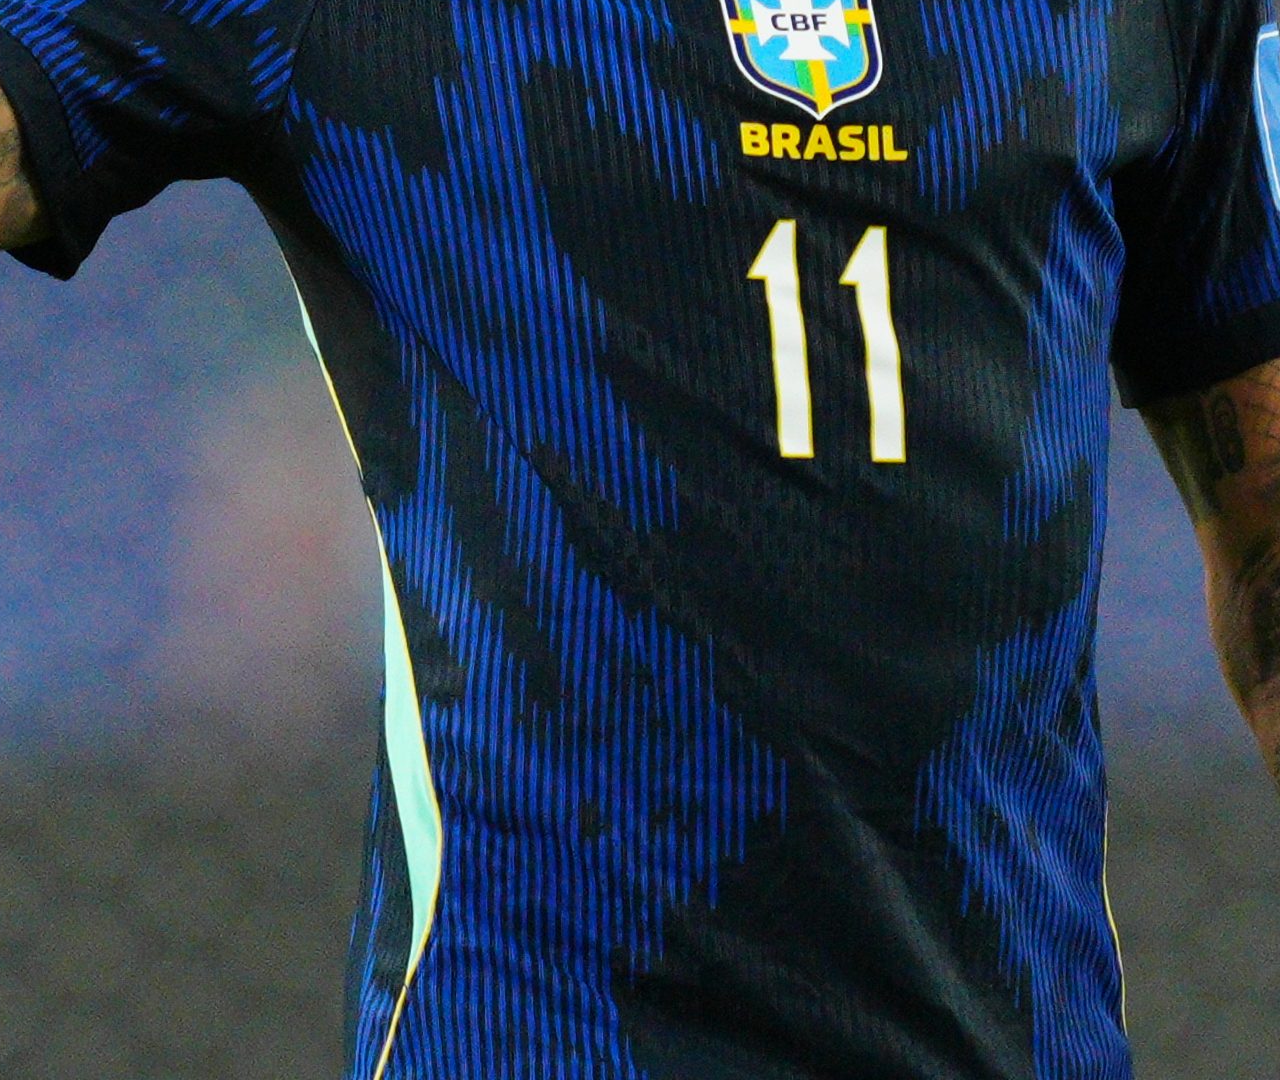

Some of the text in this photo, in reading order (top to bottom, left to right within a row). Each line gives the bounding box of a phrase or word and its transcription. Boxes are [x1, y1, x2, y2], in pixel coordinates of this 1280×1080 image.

[770, 13, 828, 32] CBF
[740, 121, 909, 162] BRASIL
[746, 219, 907, 464] 11
